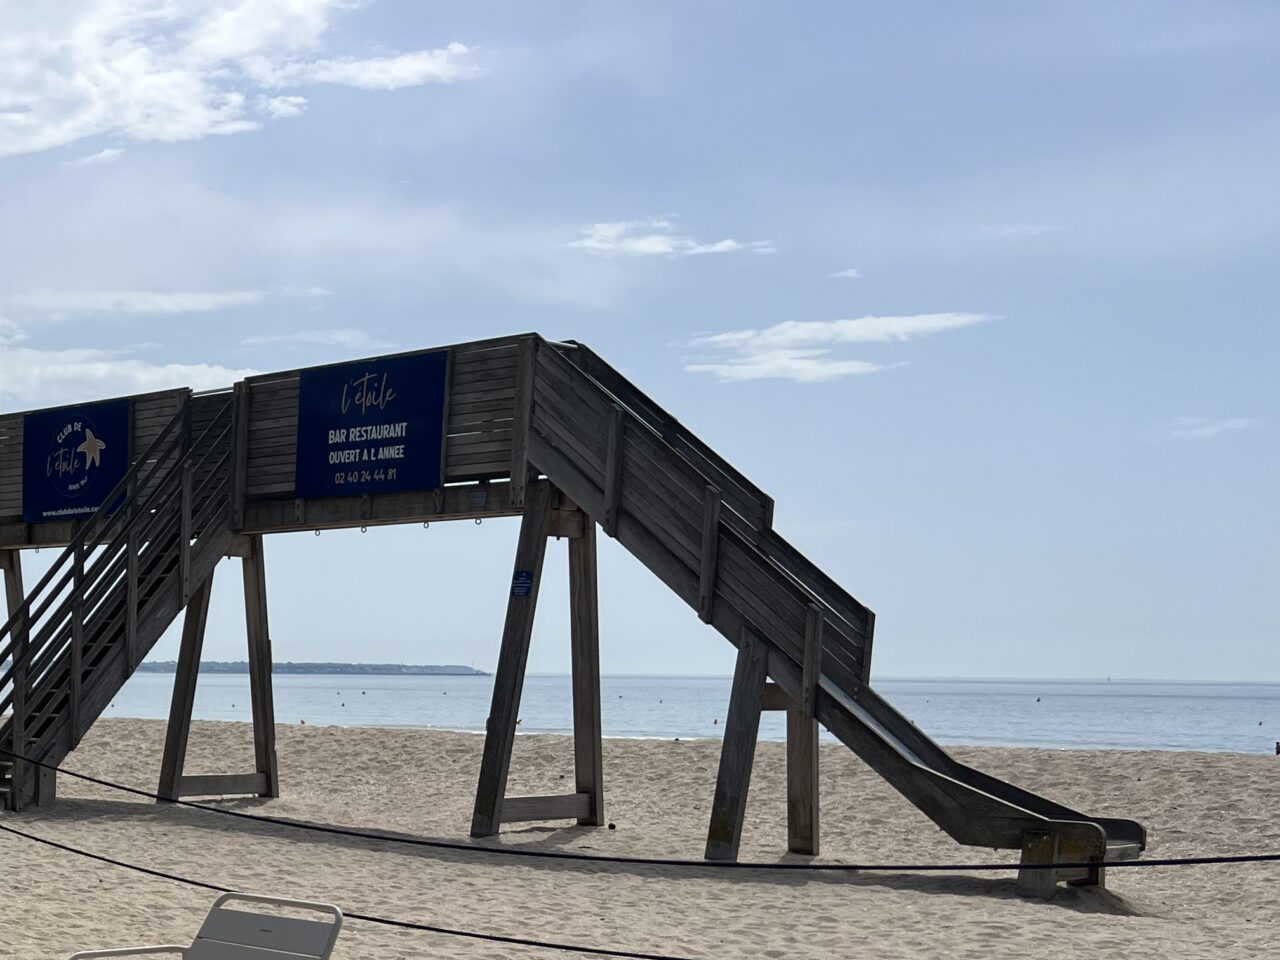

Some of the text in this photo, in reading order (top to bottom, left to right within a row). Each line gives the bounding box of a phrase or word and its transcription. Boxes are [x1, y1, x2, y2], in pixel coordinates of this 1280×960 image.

[57, 422, 82, 443] CLUB DE
[328, 422, 408, 444] BAR RESTAURANT
[328, 449, 361, 464] OUVERT
[362, 450, 368, 461] A
[335, 468, 396, 484] 02 40 24 44 81
